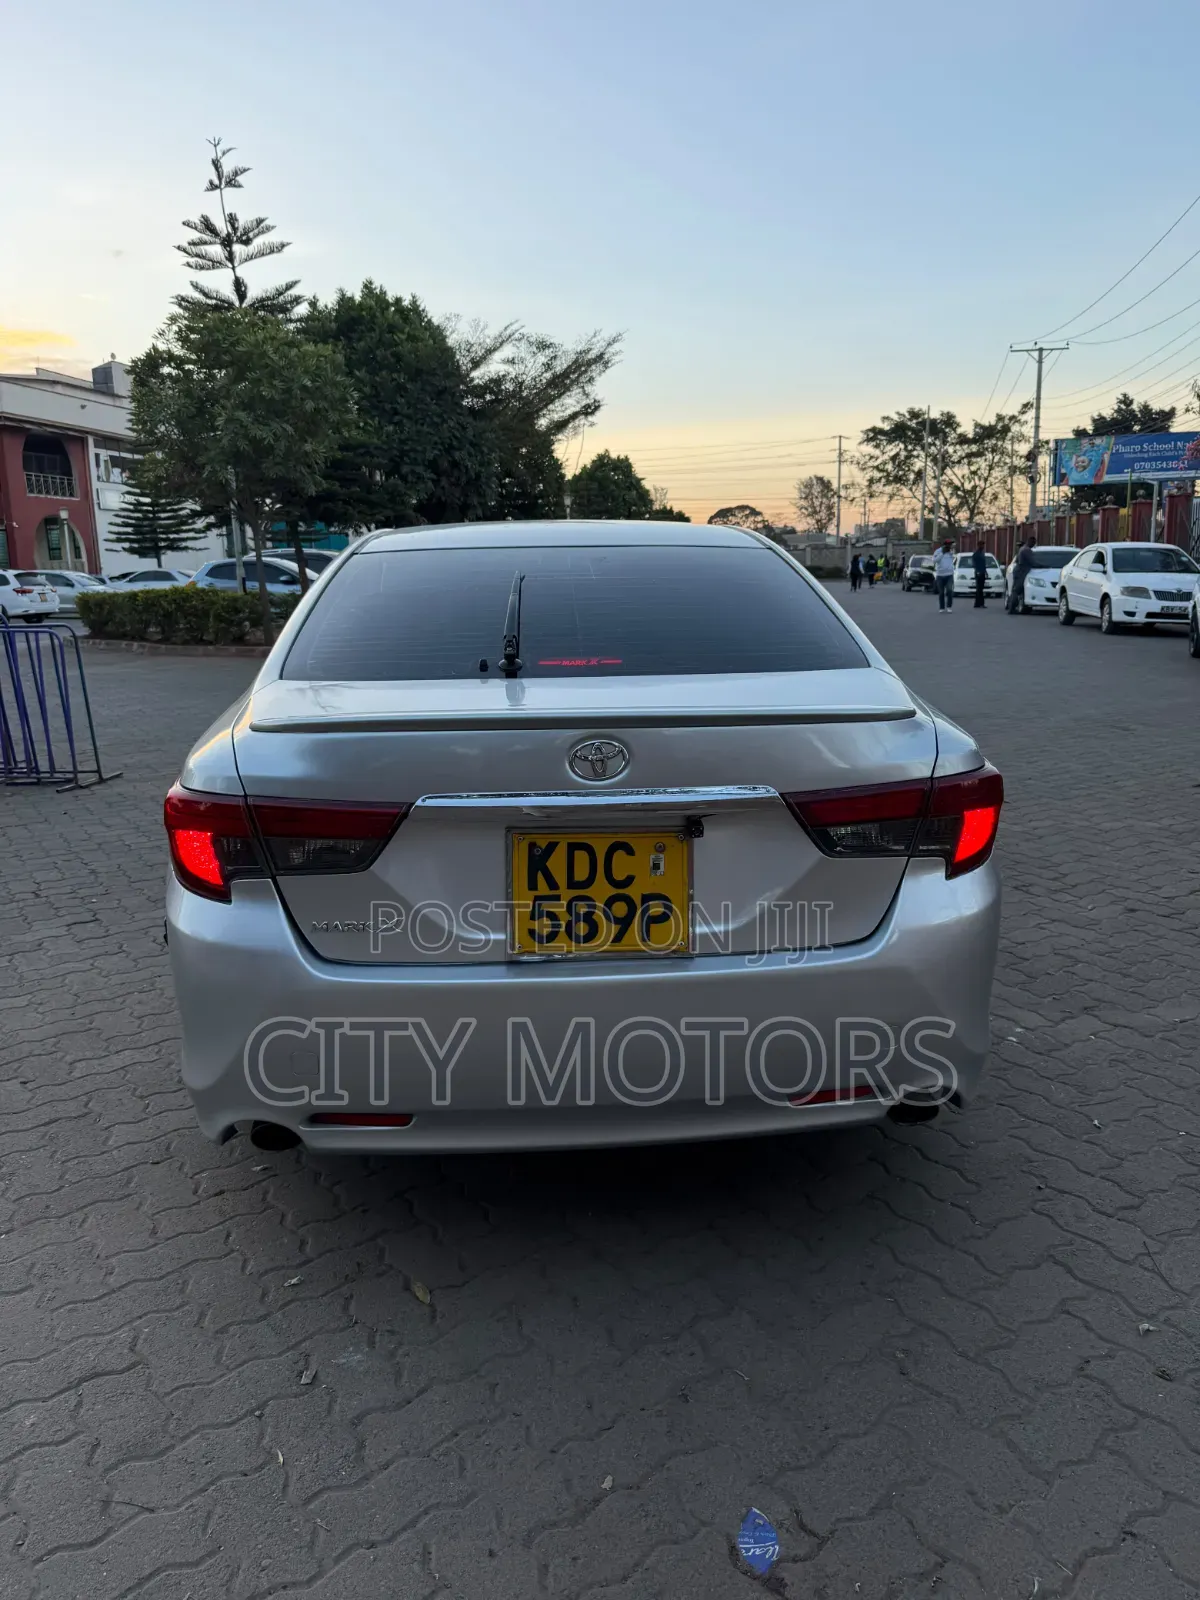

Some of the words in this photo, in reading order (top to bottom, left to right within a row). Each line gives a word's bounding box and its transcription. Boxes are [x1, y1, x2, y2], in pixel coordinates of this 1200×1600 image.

[1112, 444, 1141, 453] Pharo
[1143, 441, 1174, 452] School
[527, 841, 636, 891] KDC
[311, 921, 374, 933] MARK
[375, 917, 404, 933] X
[527, 892, 674, 944] 589P
